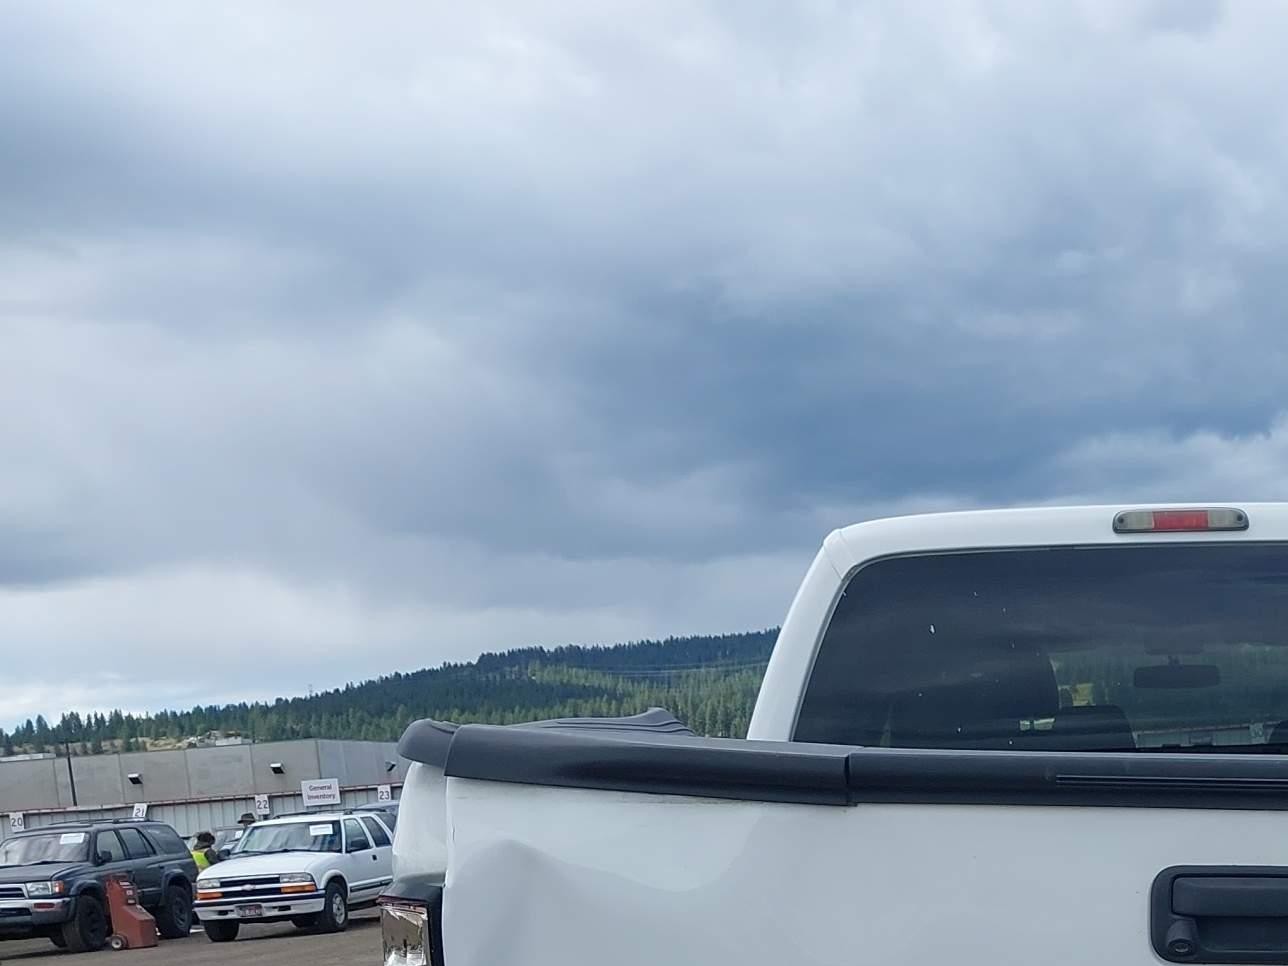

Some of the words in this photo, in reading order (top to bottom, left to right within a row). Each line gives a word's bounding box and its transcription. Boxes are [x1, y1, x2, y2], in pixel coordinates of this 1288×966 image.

[308, 784, 333, 792] General
[307, 793, 335, 801] Inventory
[379, 790, 390, 801] 23
[256, 800, 269, 810] 22
[135, 808, 145, 818] 21
[10, 817, 24, 828] 20
